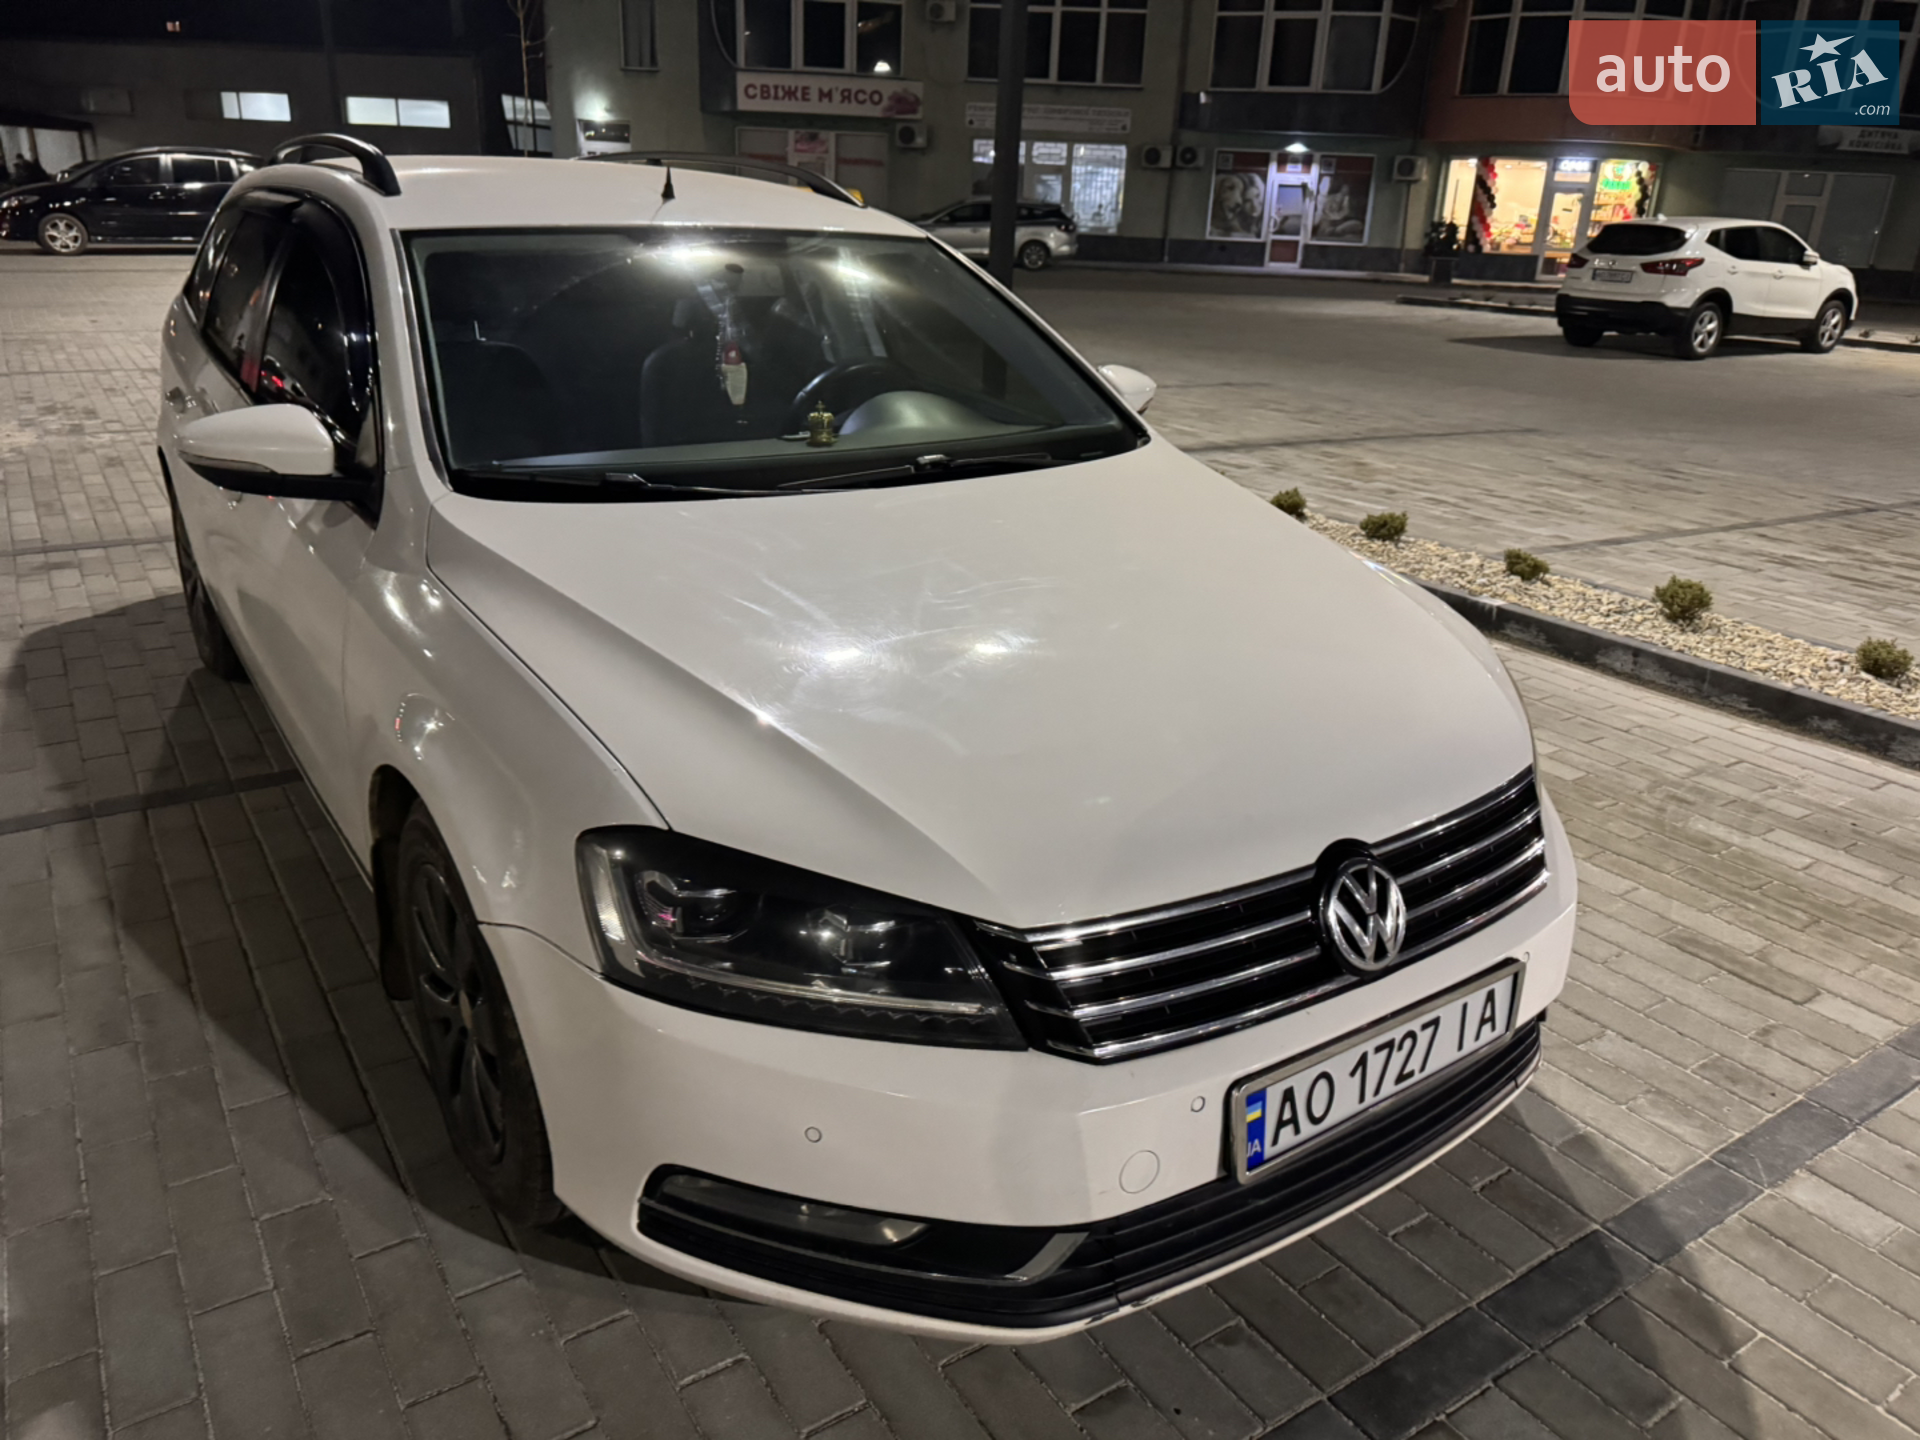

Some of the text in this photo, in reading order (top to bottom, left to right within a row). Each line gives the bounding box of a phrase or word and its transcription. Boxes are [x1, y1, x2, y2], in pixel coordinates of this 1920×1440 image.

[743, 83, 884, 106] СВІЖЕ М'ЯСО
[1270, 986, 1497, 1147] AO 1727 IA
